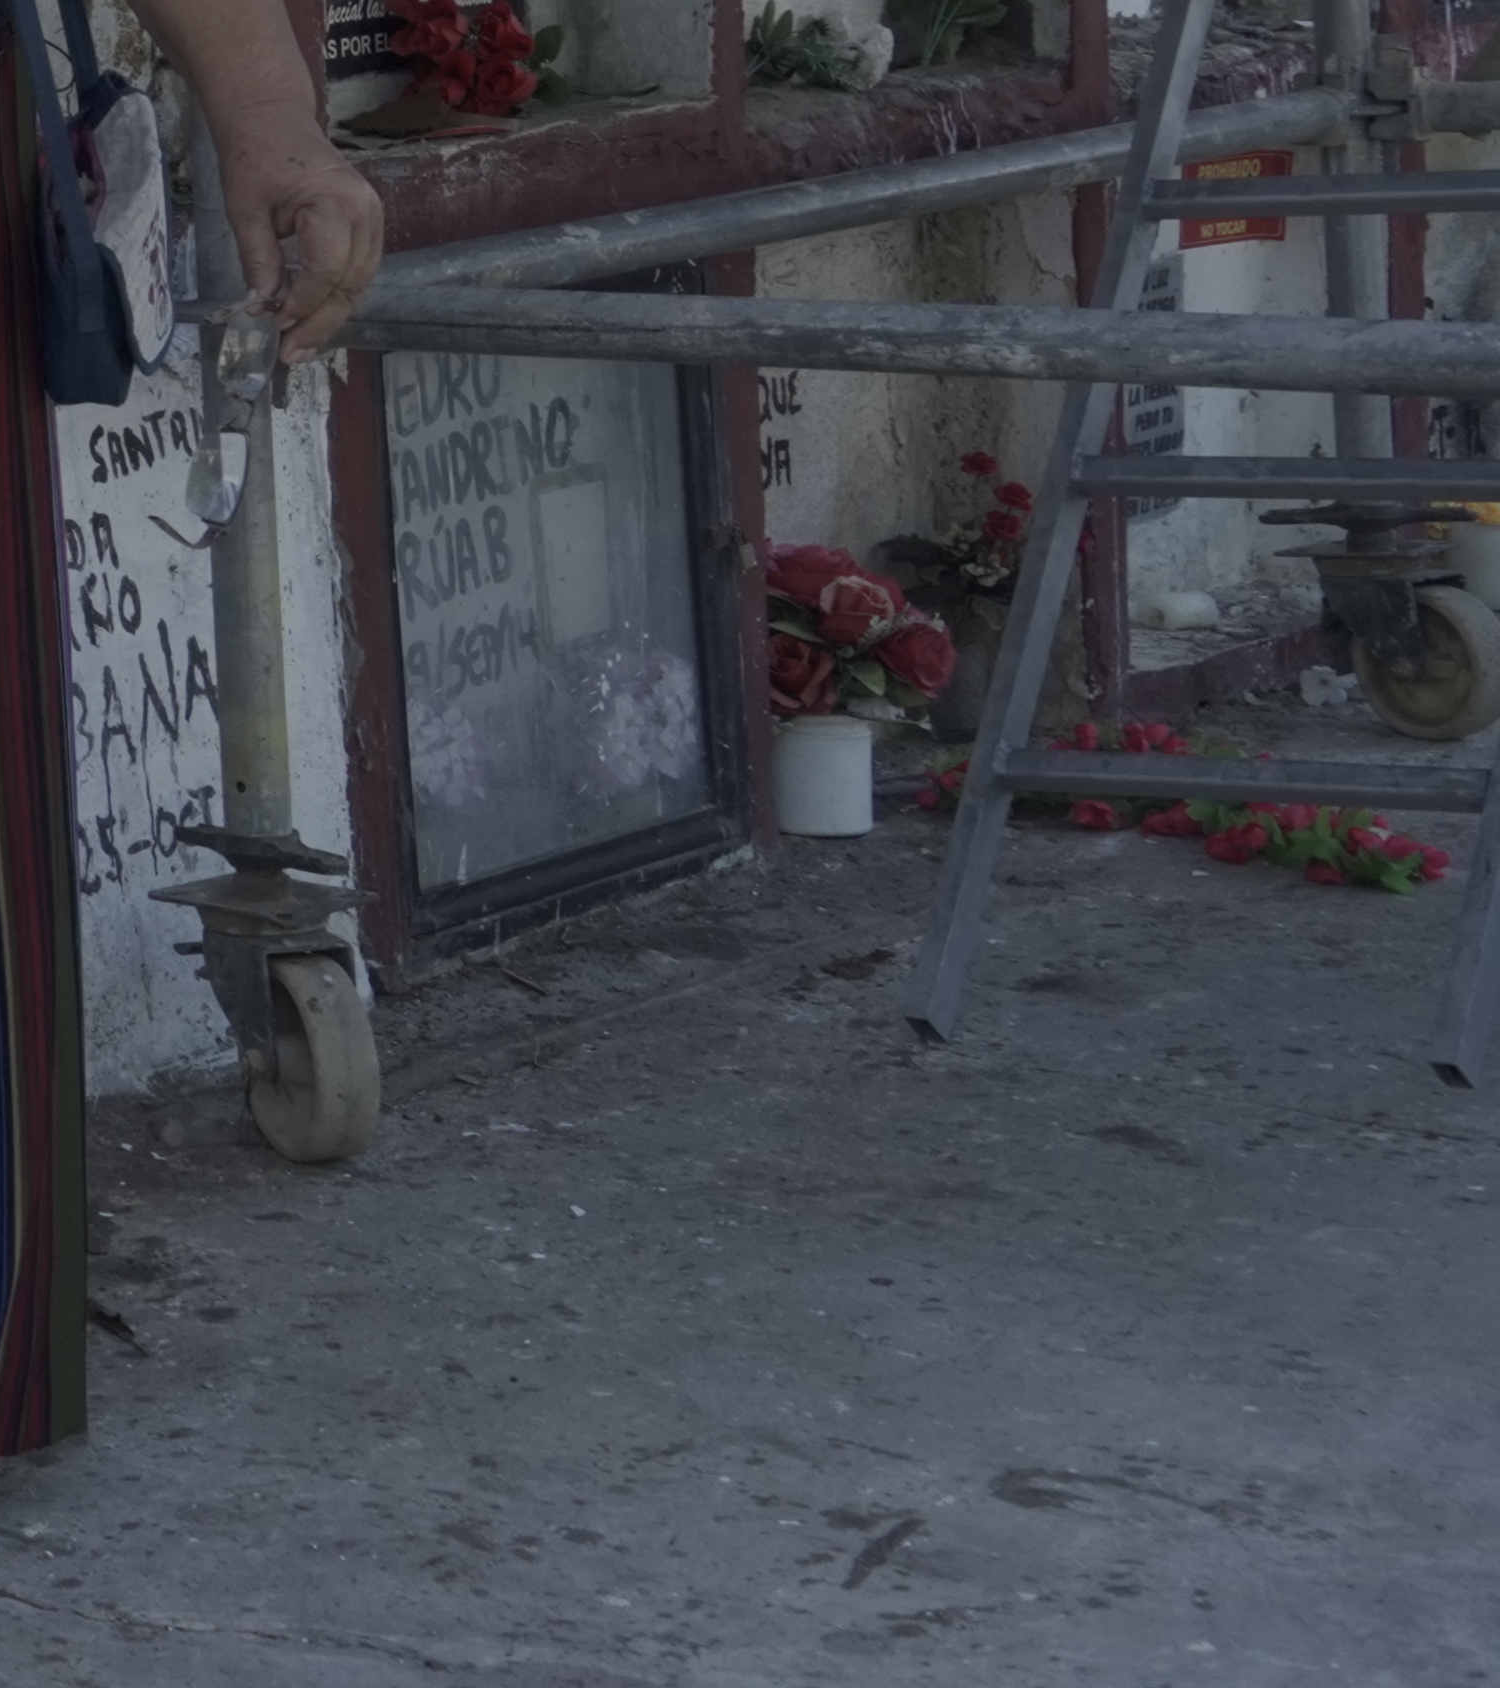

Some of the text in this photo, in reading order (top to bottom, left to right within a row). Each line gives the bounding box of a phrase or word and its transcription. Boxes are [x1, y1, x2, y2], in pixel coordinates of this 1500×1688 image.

[340, 36, 372, 58] POR
[1197, 157, 1261, 180] PROHIBIDO
[1199, 218, 1248, 238] NO TOCAR
[393, 397, 572, 524] ANDRINO
